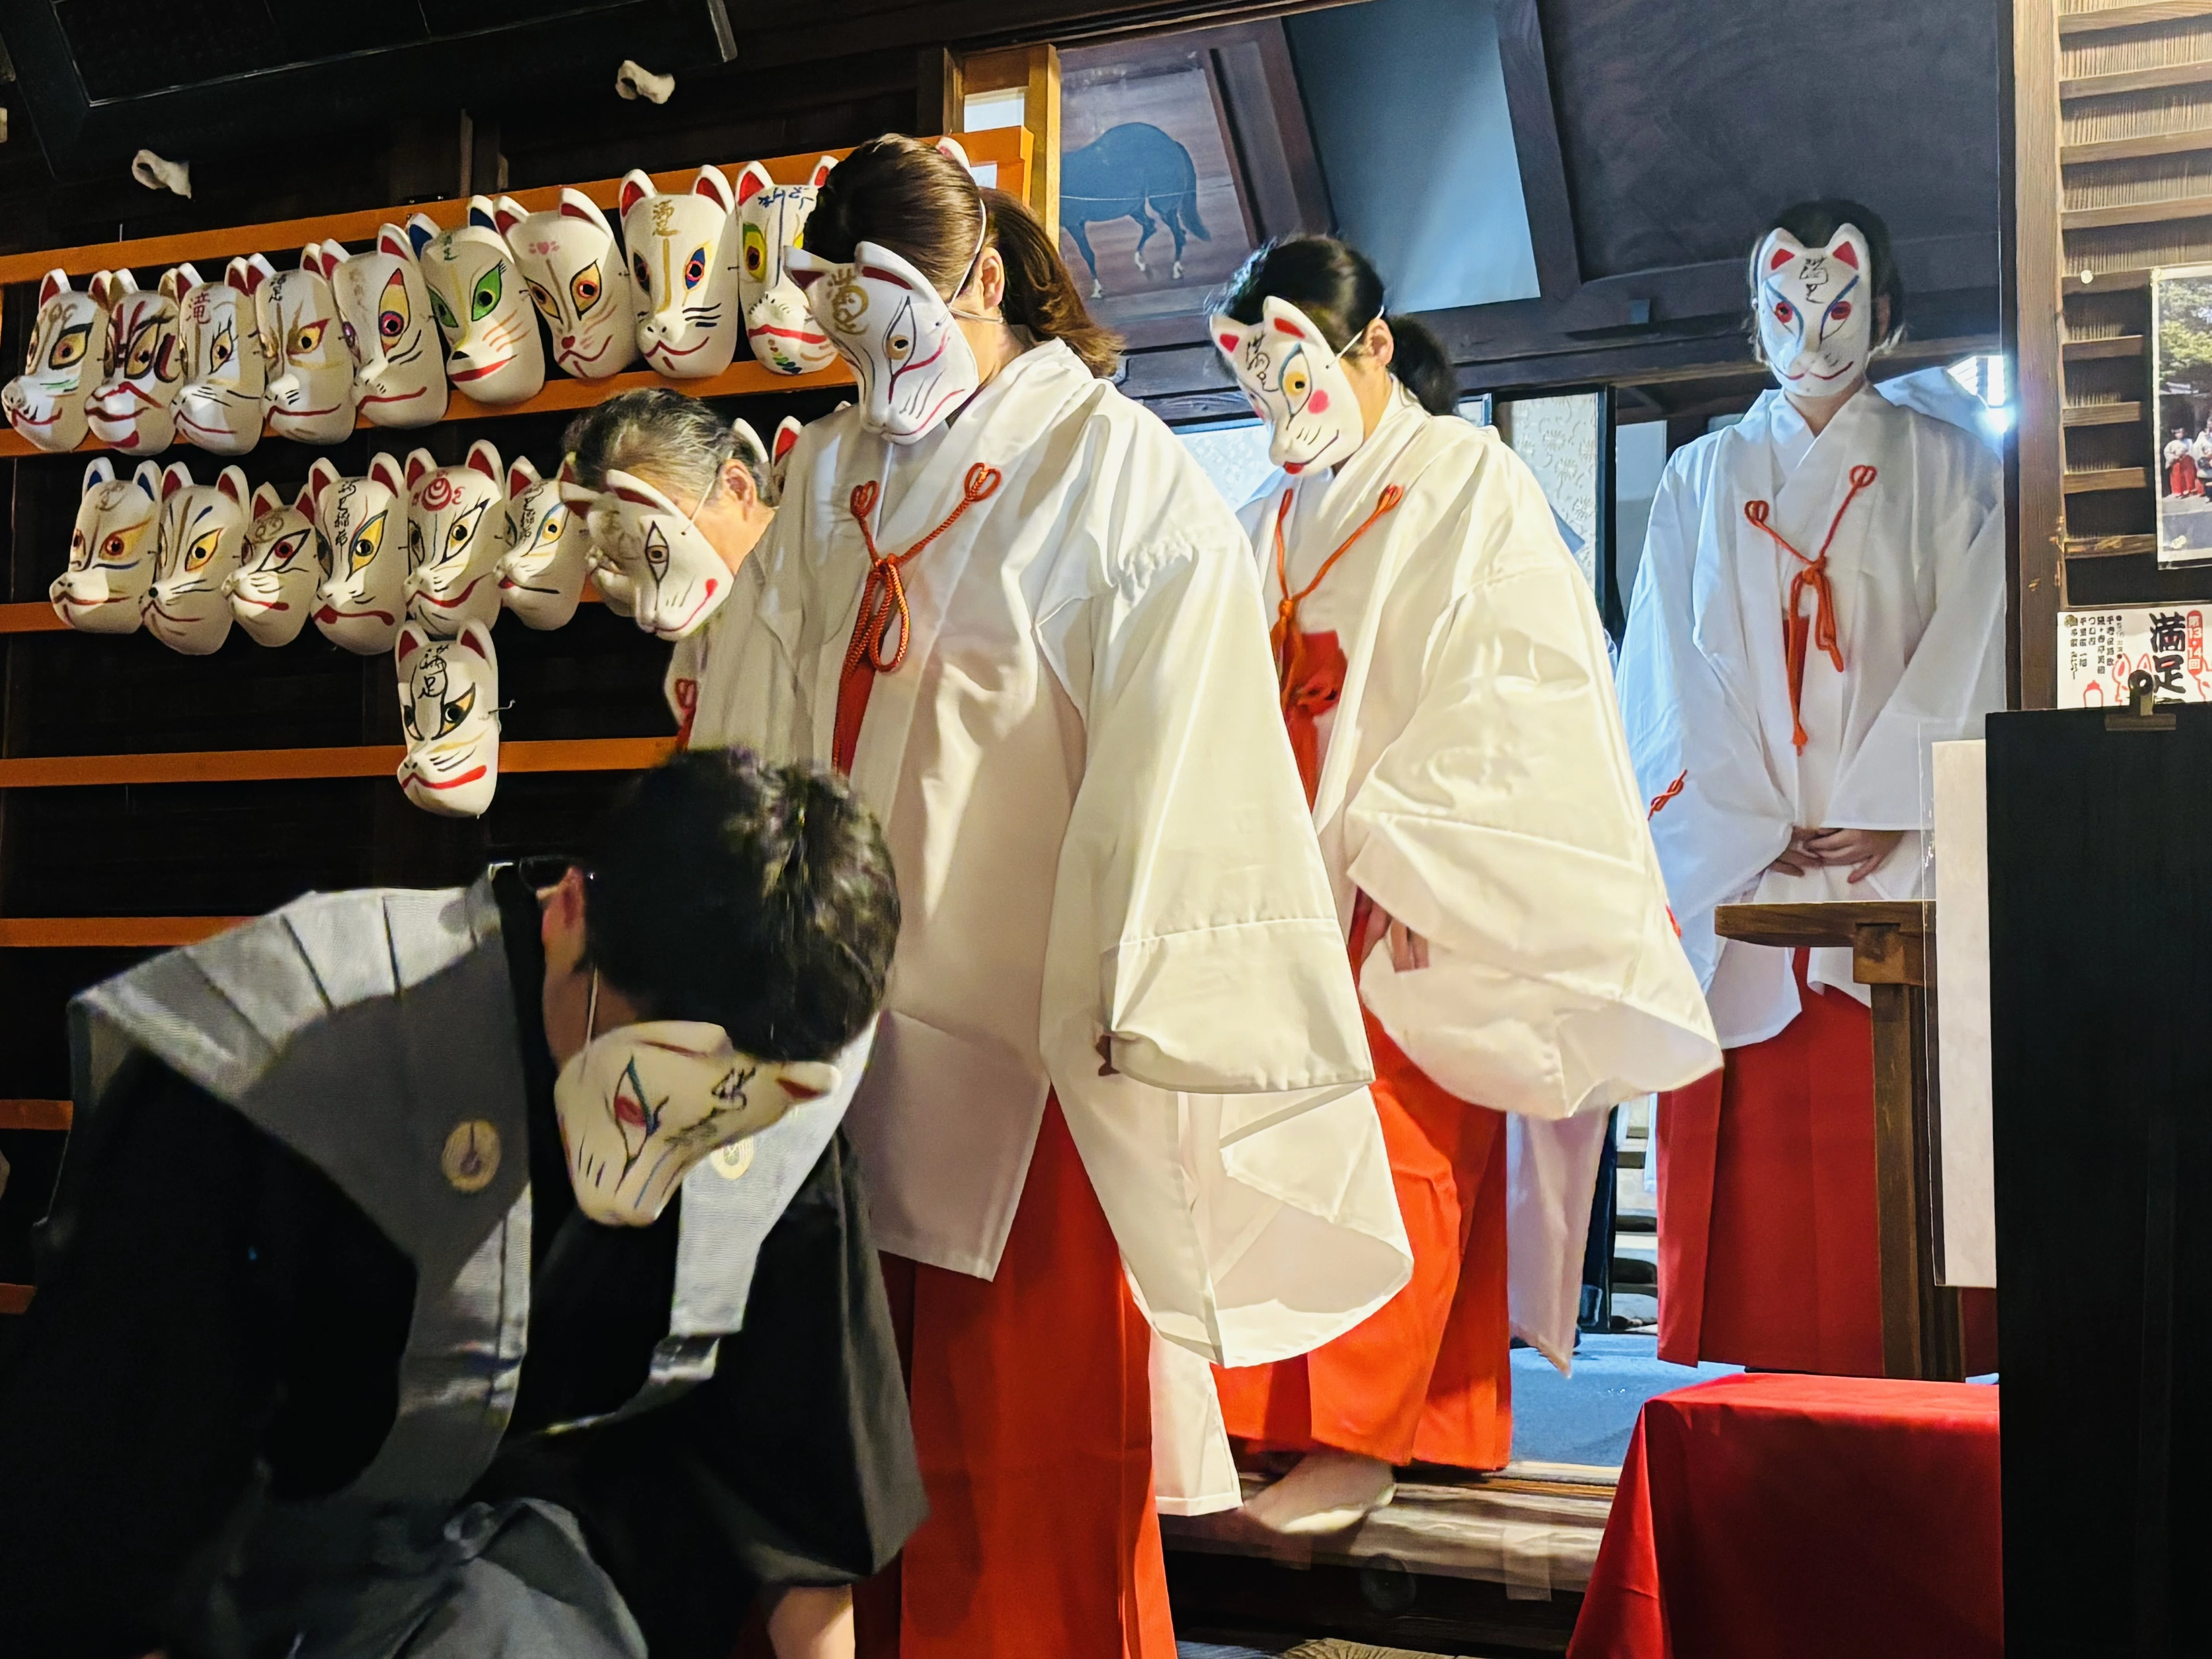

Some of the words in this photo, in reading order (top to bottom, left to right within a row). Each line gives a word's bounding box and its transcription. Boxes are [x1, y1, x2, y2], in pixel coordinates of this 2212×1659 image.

[1800, 257, 1829, 304] 満足
[185, 292, 211, 325] 滝
[1246, 332, 1279, 392] 満足
[417, 645, 449, 699] 満足
[2150, 611, 2186, 694] 満足
